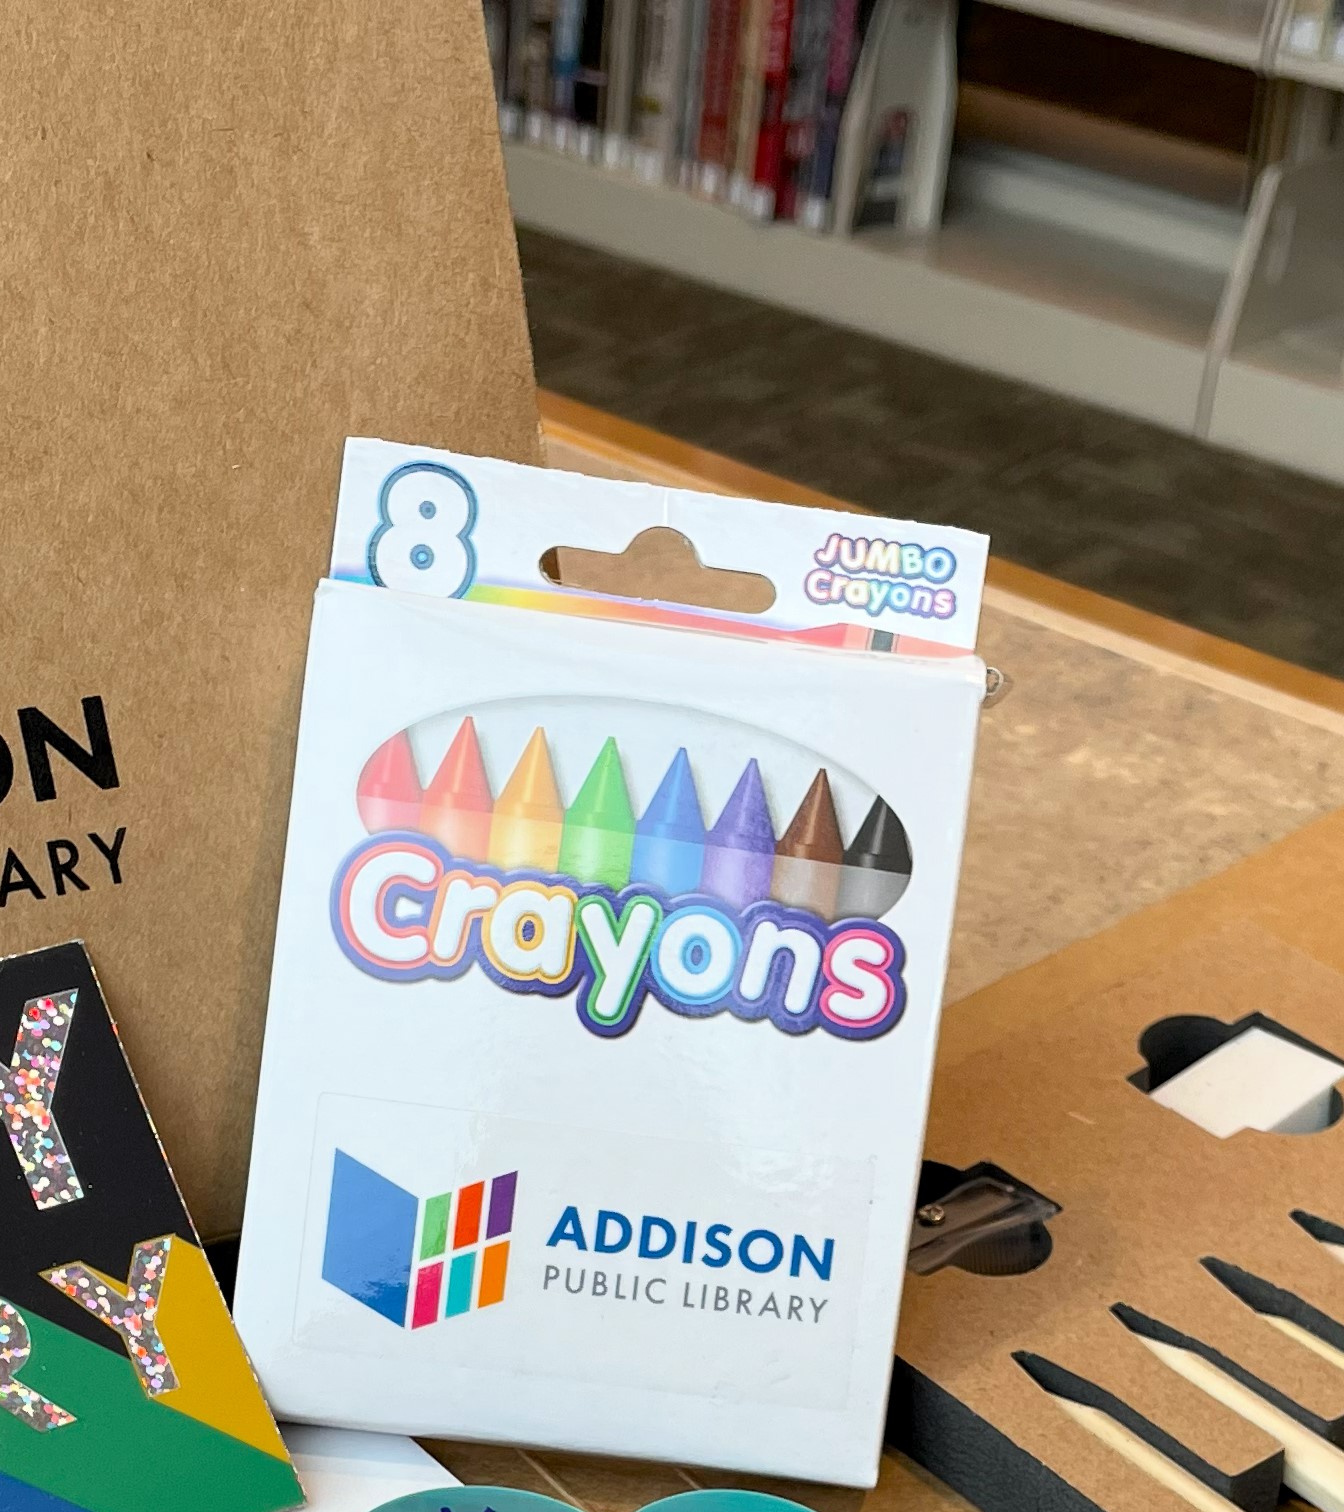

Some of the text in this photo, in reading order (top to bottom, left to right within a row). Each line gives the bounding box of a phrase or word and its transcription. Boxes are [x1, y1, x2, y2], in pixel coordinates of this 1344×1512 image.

[367, 460, 477, 600] 8
[814, 533, 957, 584] JUMBO
[805, 568, 957, 620] Crayons
[331, 831, 907, 1041] Crayons
[546, 1205, 835, 1281] ADDISON
[543, 1265, 829, 1324] PUBLIC LIBRARY
